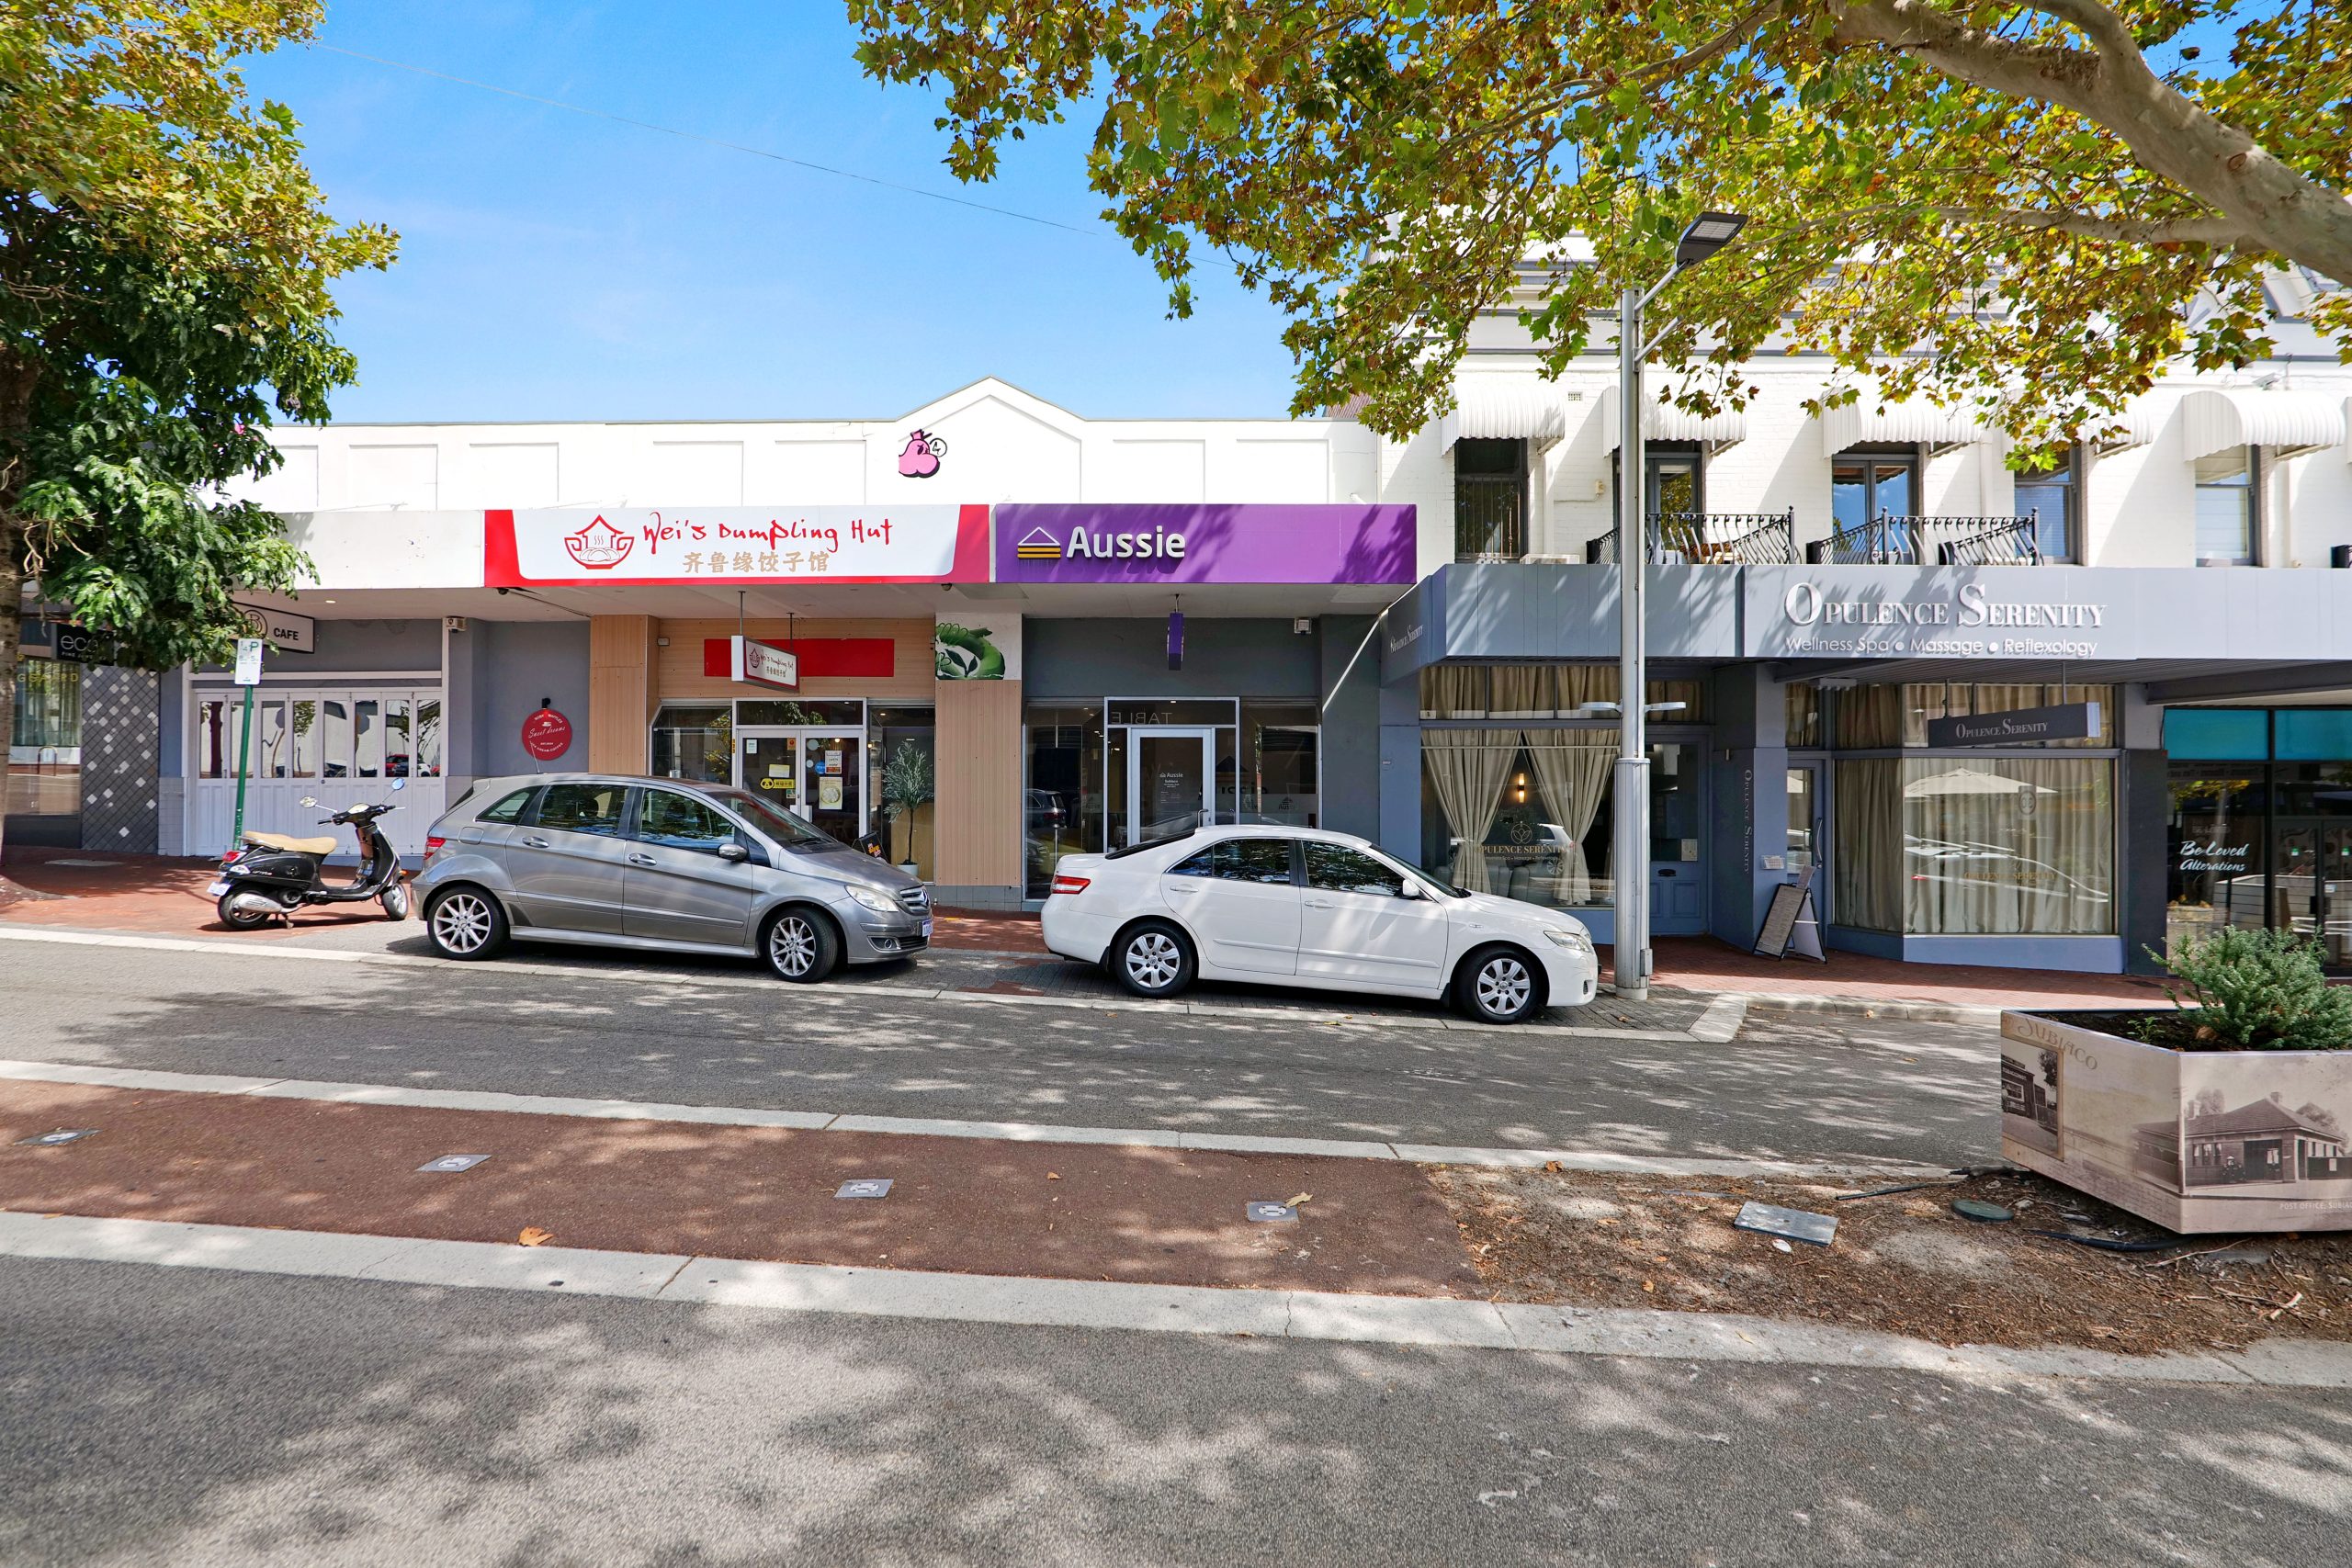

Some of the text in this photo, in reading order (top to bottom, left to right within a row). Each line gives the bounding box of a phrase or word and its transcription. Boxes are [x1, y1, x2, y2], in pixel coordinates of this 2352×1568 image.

[643, 512, 893, 555] Wei's Dumpling Hut
[1067, 525, 1186, 558] Aussie
[683, 551, 830, 574] 齐鲁缘饺子馆
[1785, 581, 2108, 628] OPULENCE SERENITY
[273, 627, 300, 641] CAFE
[1785, 637, 2098, 657] Wellness Spa Massage Reflexology
[1955, 718, 2048, 739] OPULENCE SERENITY
[2180, 840, 2250, 856] Be Loved
[2179, 858, 2246, 872] Alterations
